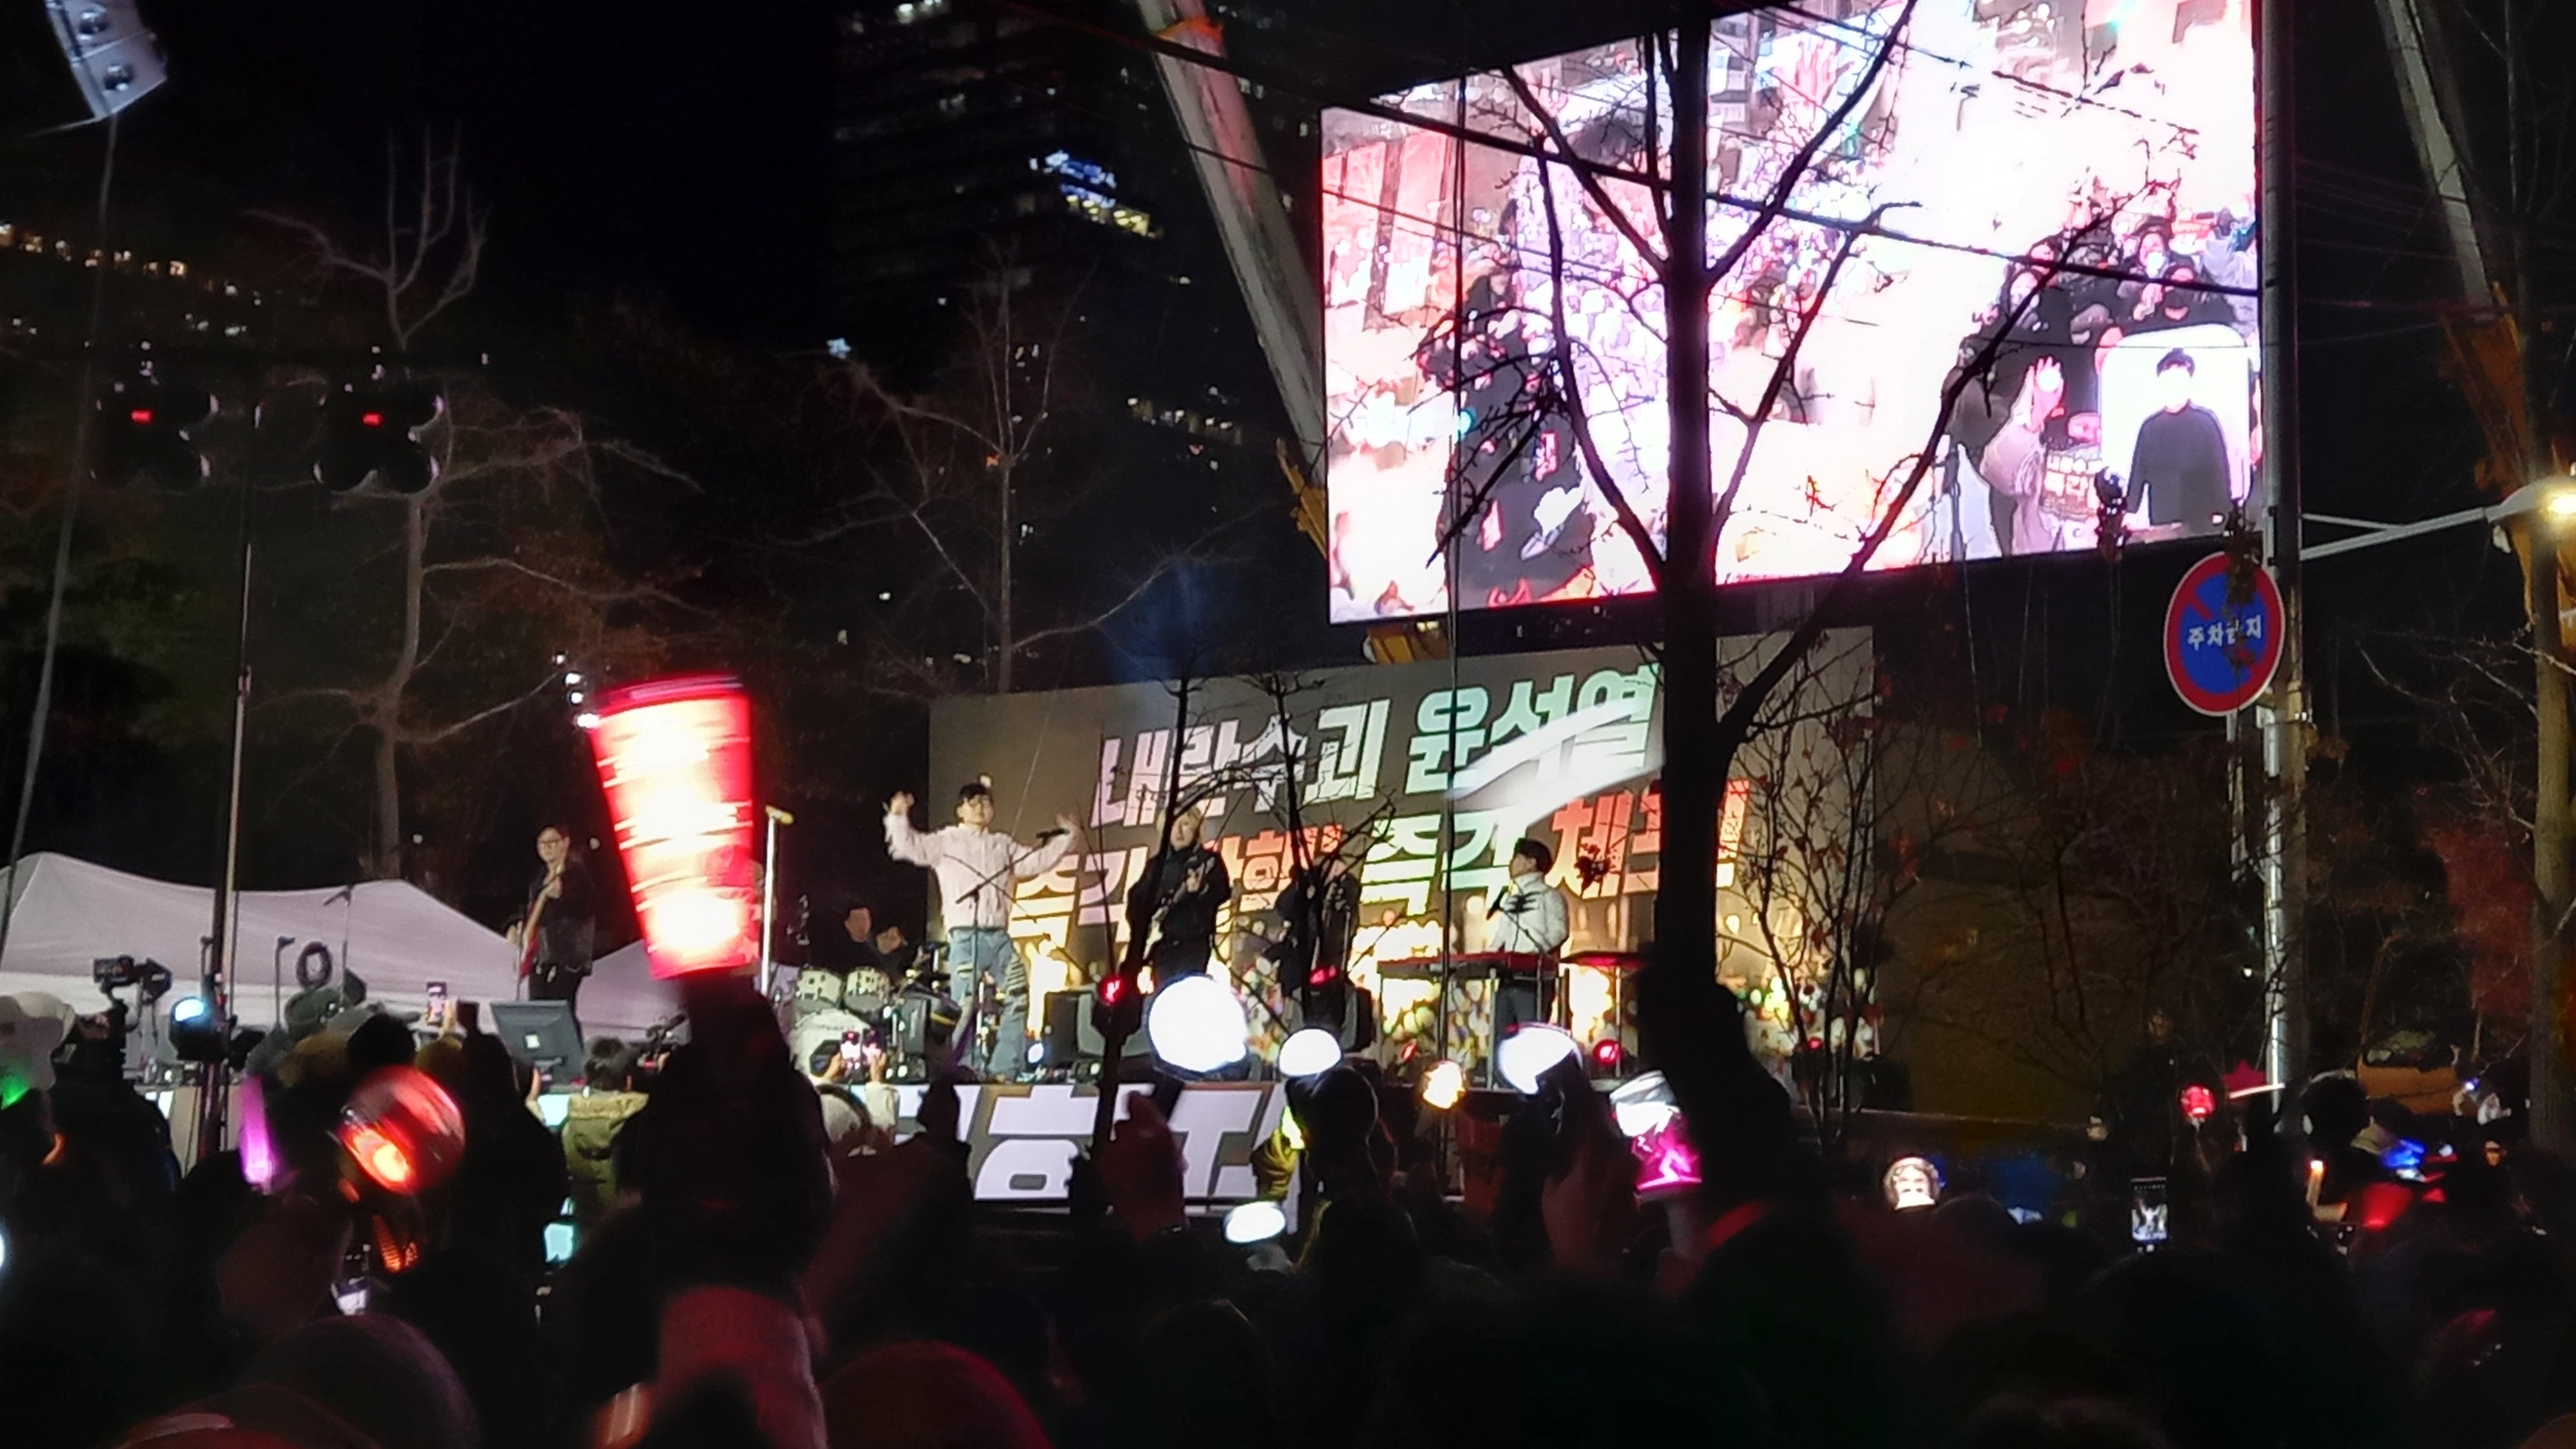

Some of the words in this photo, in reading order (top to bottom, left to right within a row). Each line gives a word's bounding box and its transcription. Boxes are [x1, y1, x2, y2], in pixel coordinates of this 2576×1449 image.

[1090, 699, 1390, 828] 내란수괴
[1404, 662, 1660, 794] 윤석열
[1359, 805, 1531, 916] 즉각
